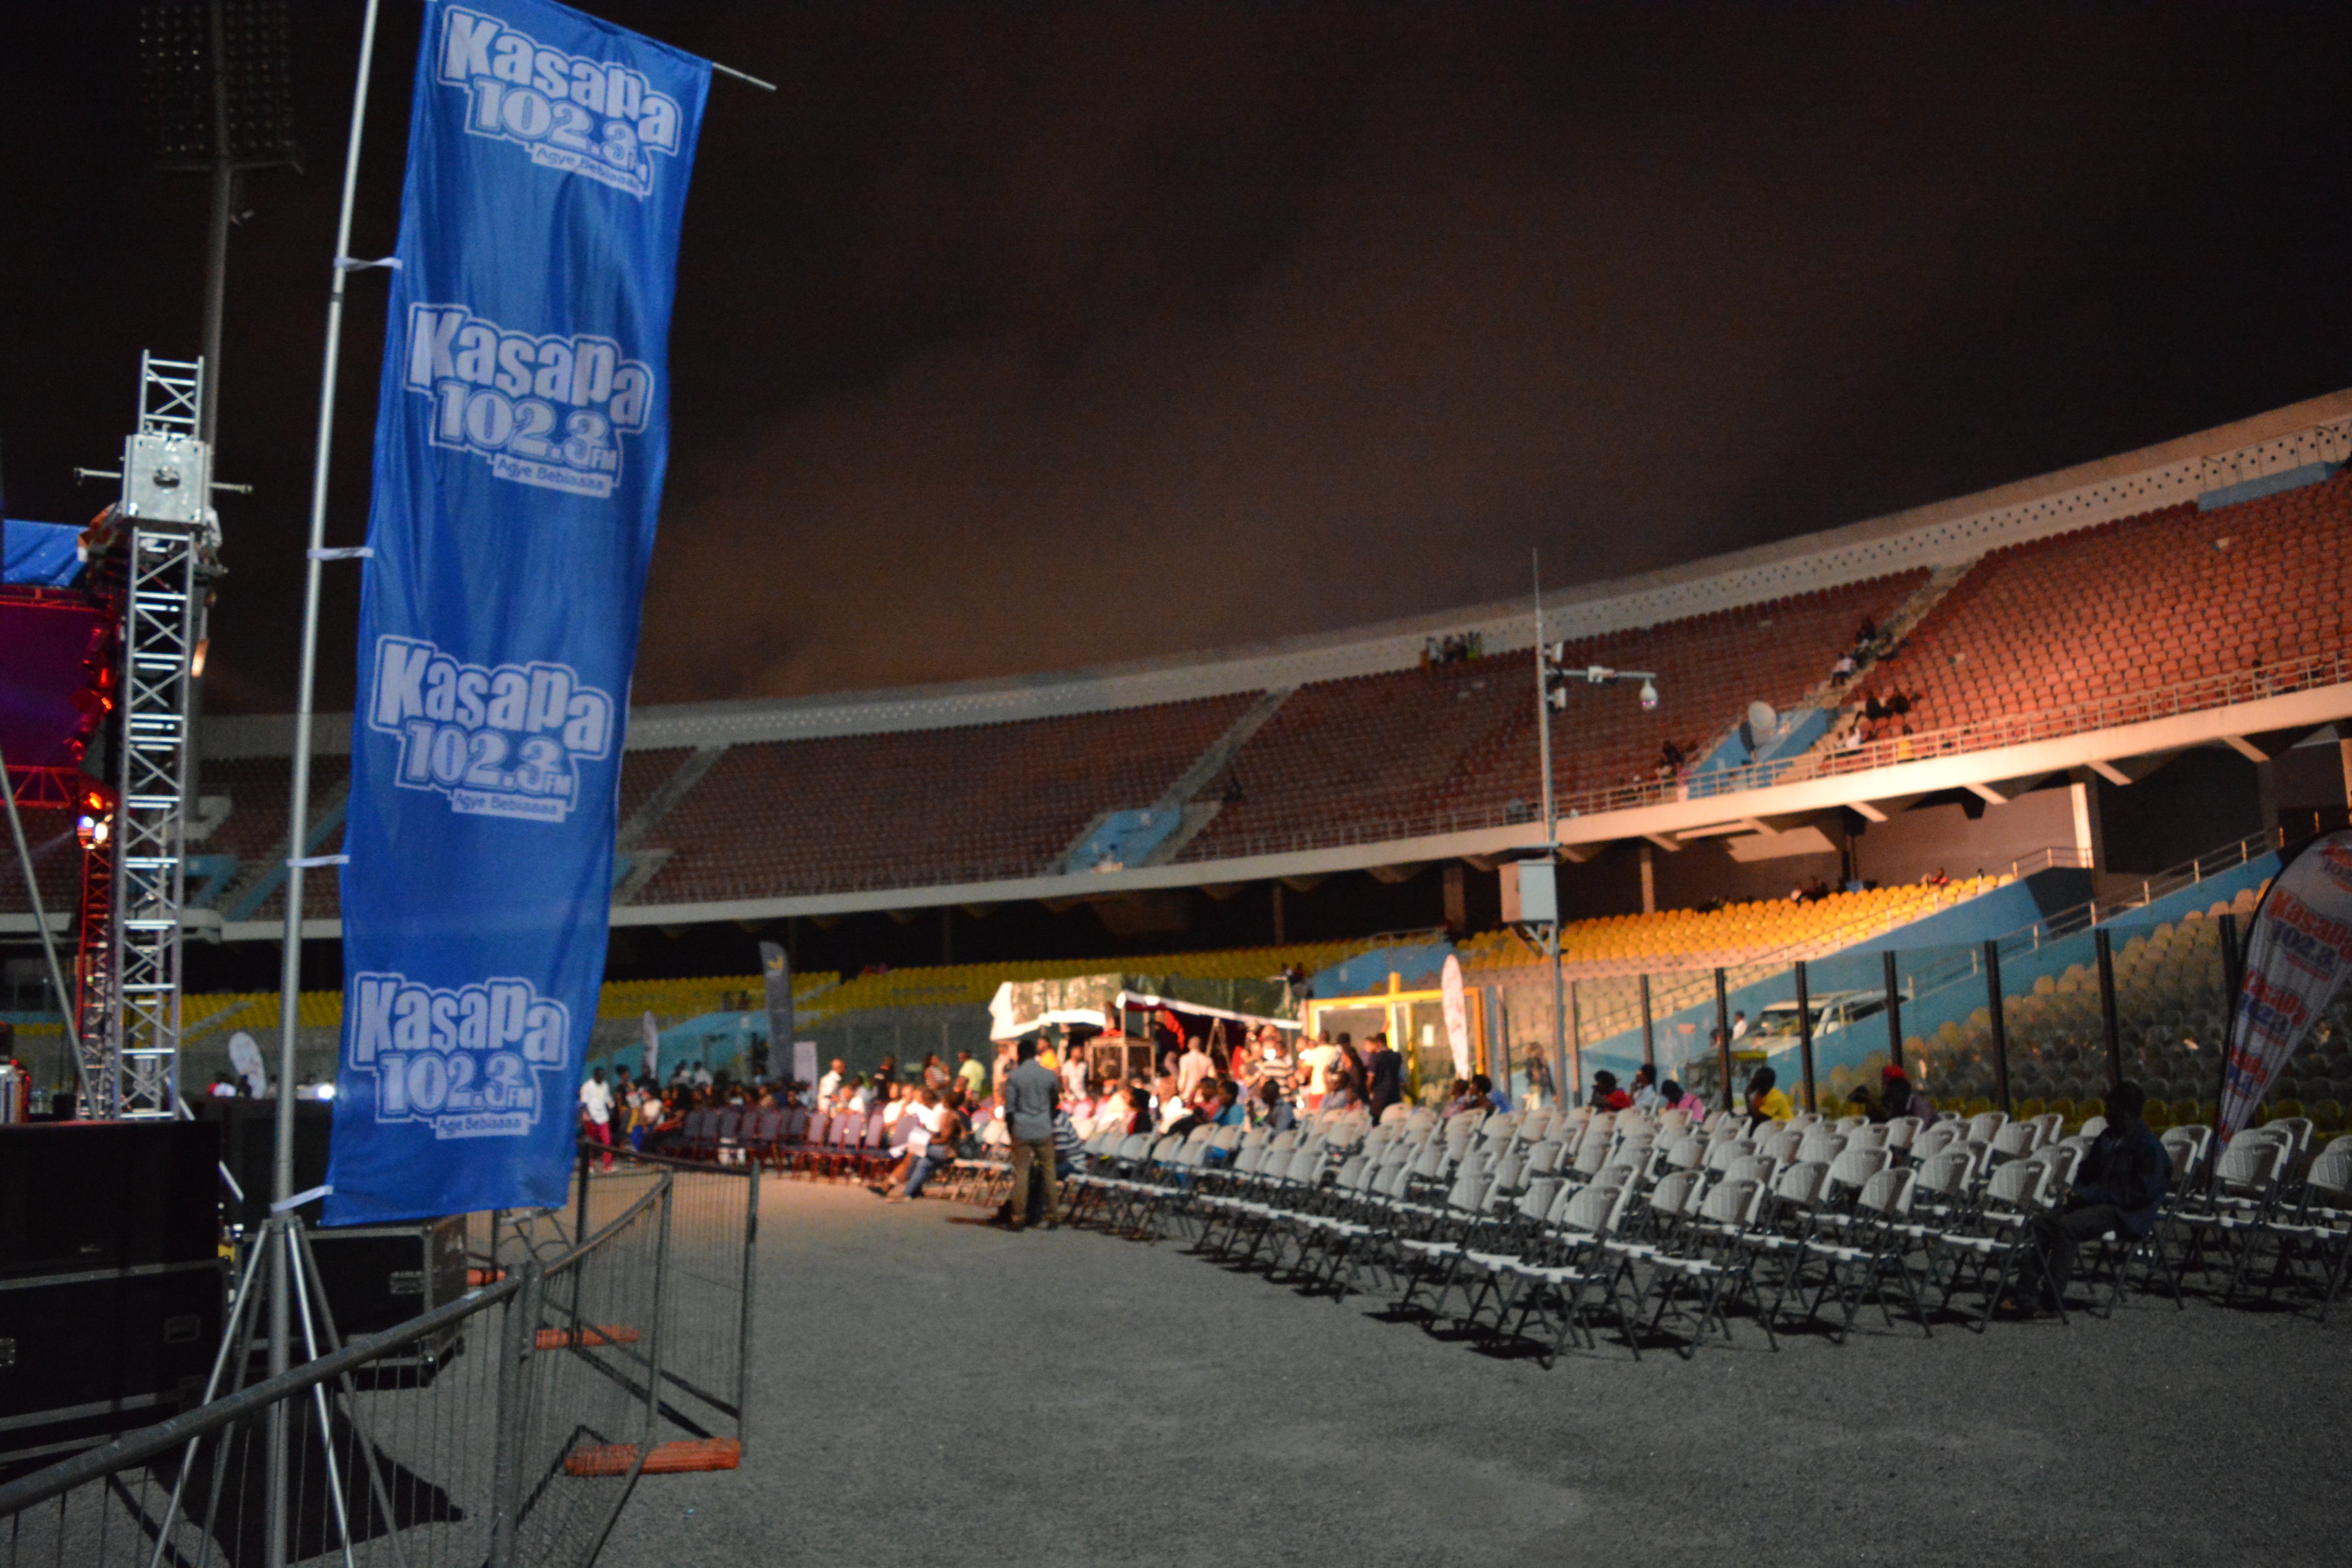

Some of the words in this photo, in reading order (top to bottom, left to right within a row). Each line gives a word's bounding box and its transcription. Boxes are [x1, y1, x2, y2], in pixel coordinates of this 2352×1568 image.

[444, 12, 677, 148] Kasapa
[475, 77, 642, 167] 102.3
[410, 311, 645, 425] Kasapa
[437, 380, 609, 470] 102.3
[379, 643, 606, 752] Kasapa
[406, 719, 563, 795] 102.3
[357, 980, 562, 1062] Kasapa
[379, 1052, 524, 1114] 102.3
